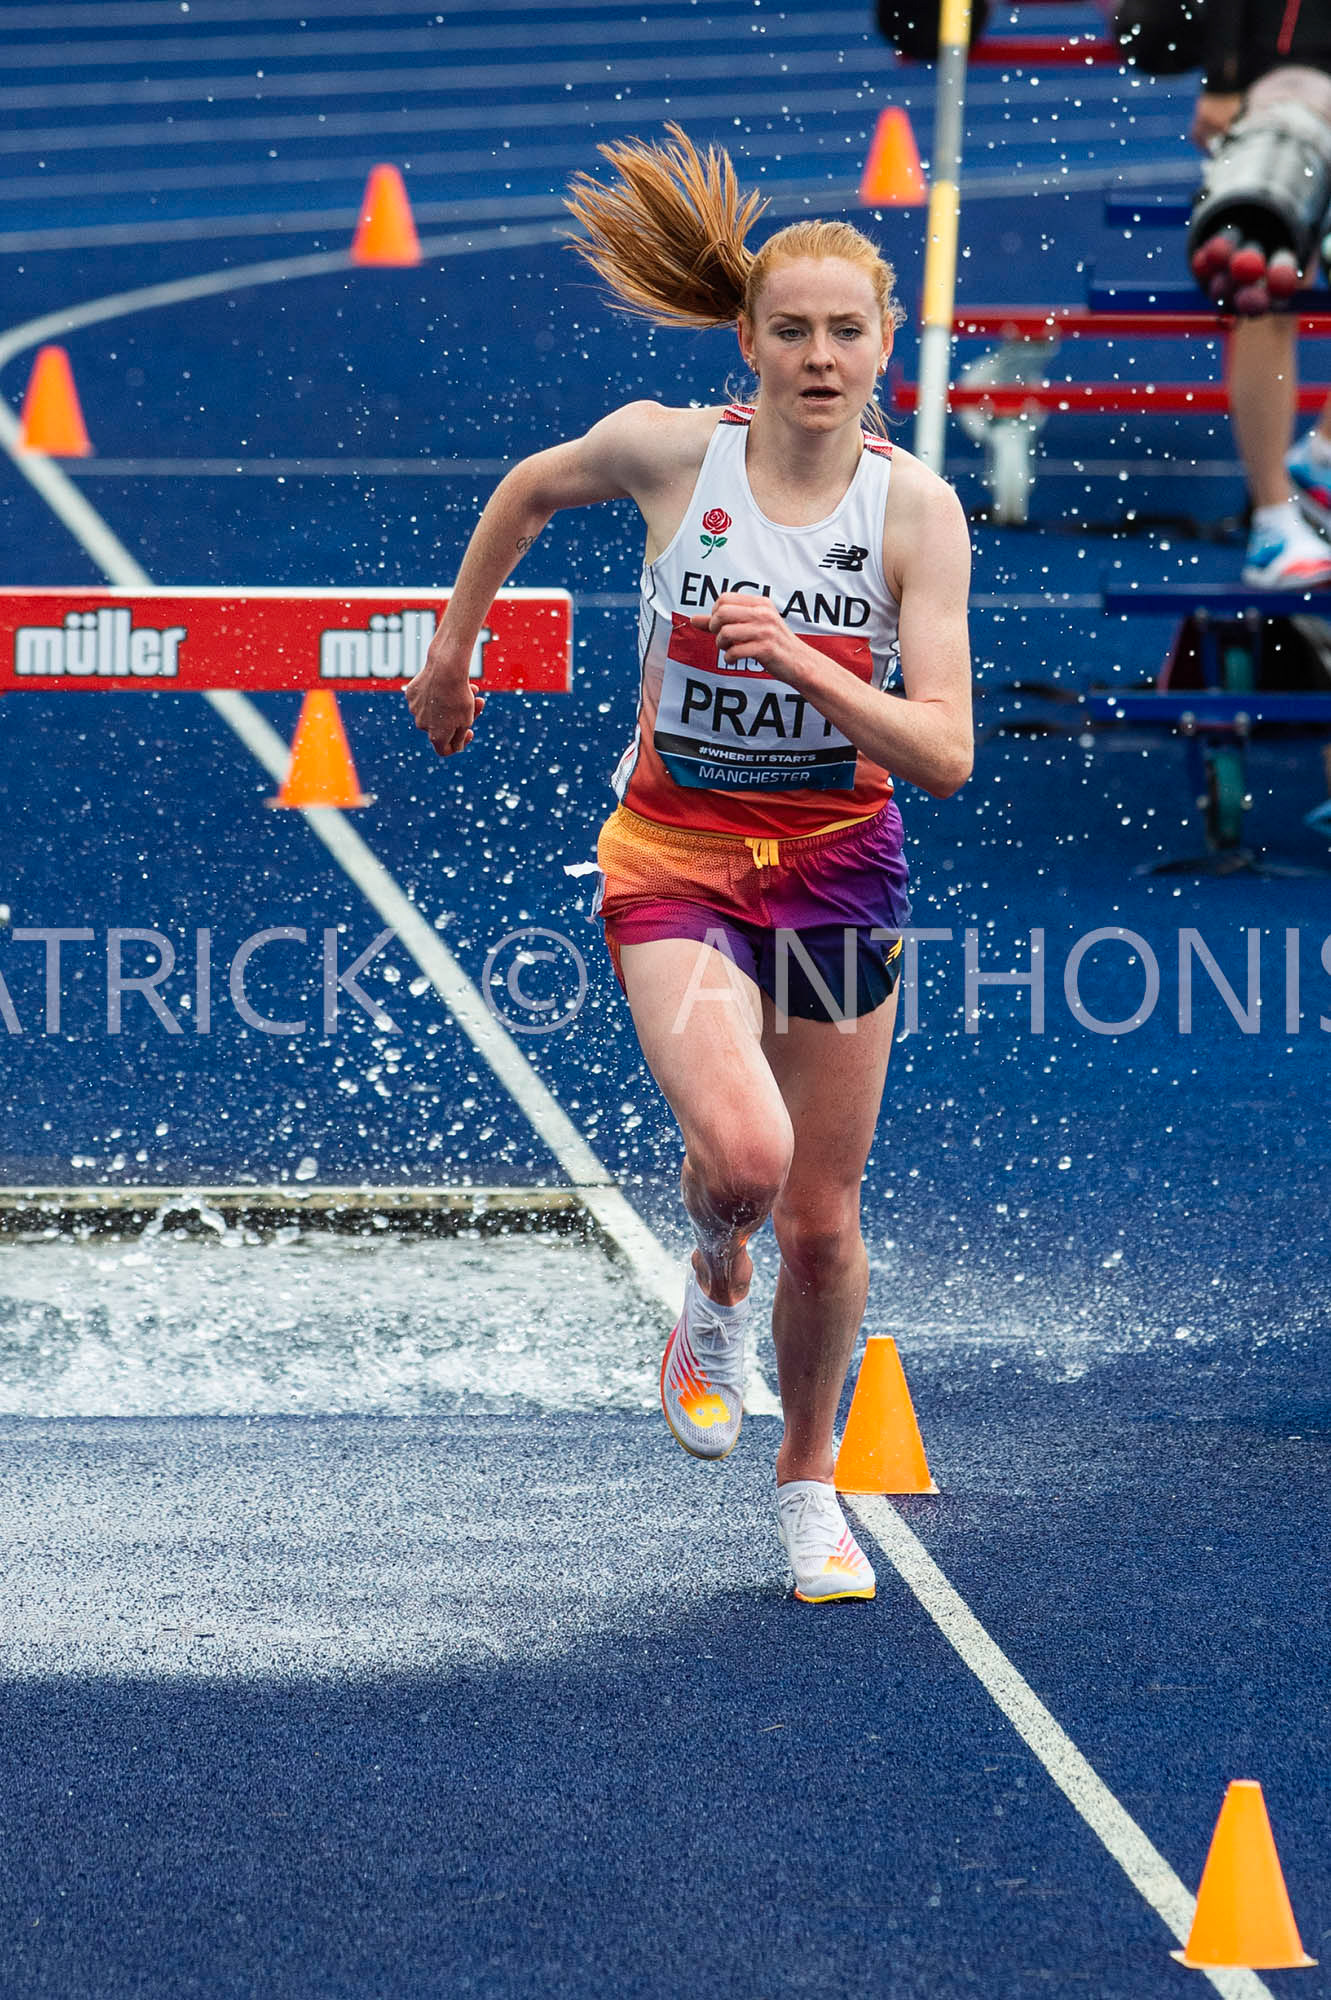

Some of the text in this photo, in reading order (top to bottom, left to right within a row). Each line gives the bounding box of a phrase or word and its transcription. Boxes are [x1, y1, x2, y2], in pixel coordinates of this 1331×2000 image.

[15, 607, 188, 677] müller
[320, 609, 492, 679] müllr
[699, 765, 810, 784] MANCHESTER
